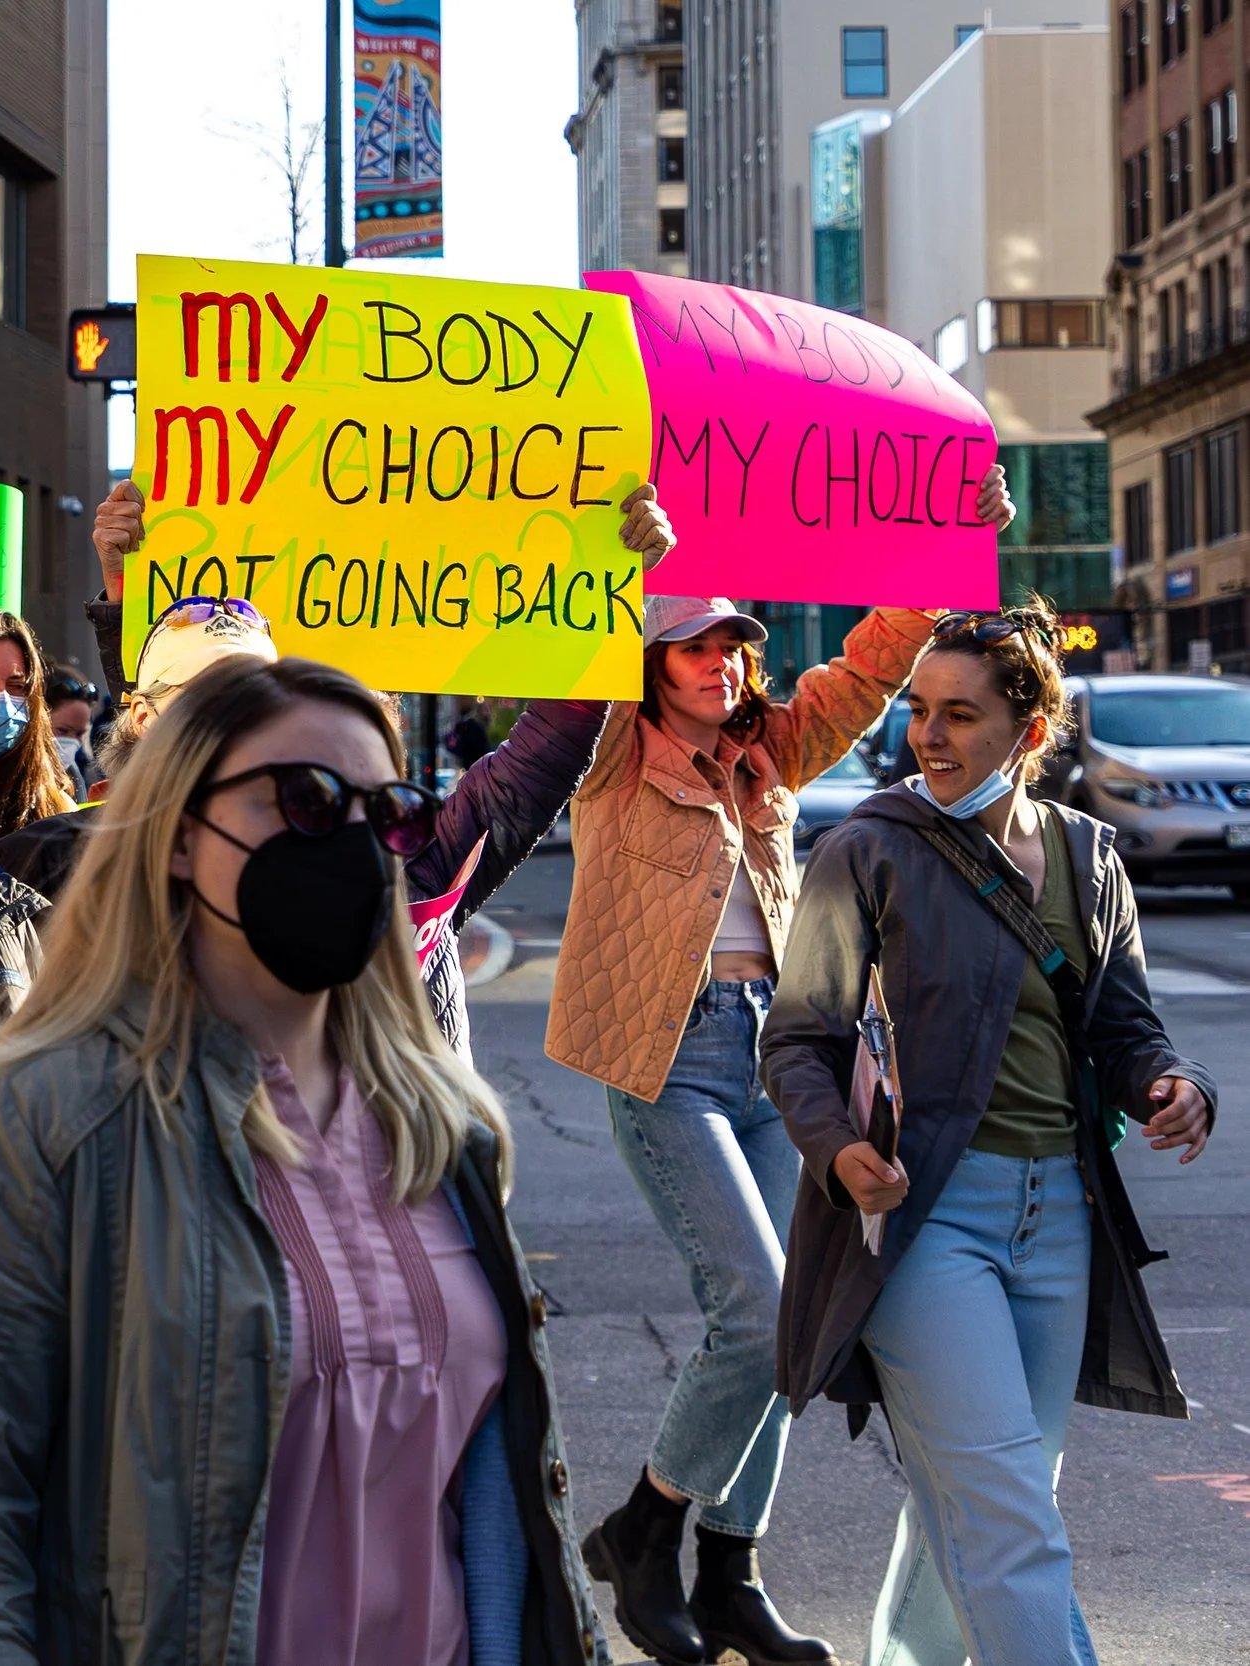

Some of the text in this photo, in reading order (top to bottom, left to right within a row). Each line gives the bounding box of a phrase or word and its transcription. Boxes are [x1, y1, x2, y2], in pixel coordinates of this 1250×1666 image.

[363, 300, 593, 398] BODY
[631, 300, 940, 396] MY BODY
[323, 418, 623, 509] CHOICE
[655, 412, 987, 530] MY CHOICE
[148, 553, 643, 635] NOT GOING BACK
